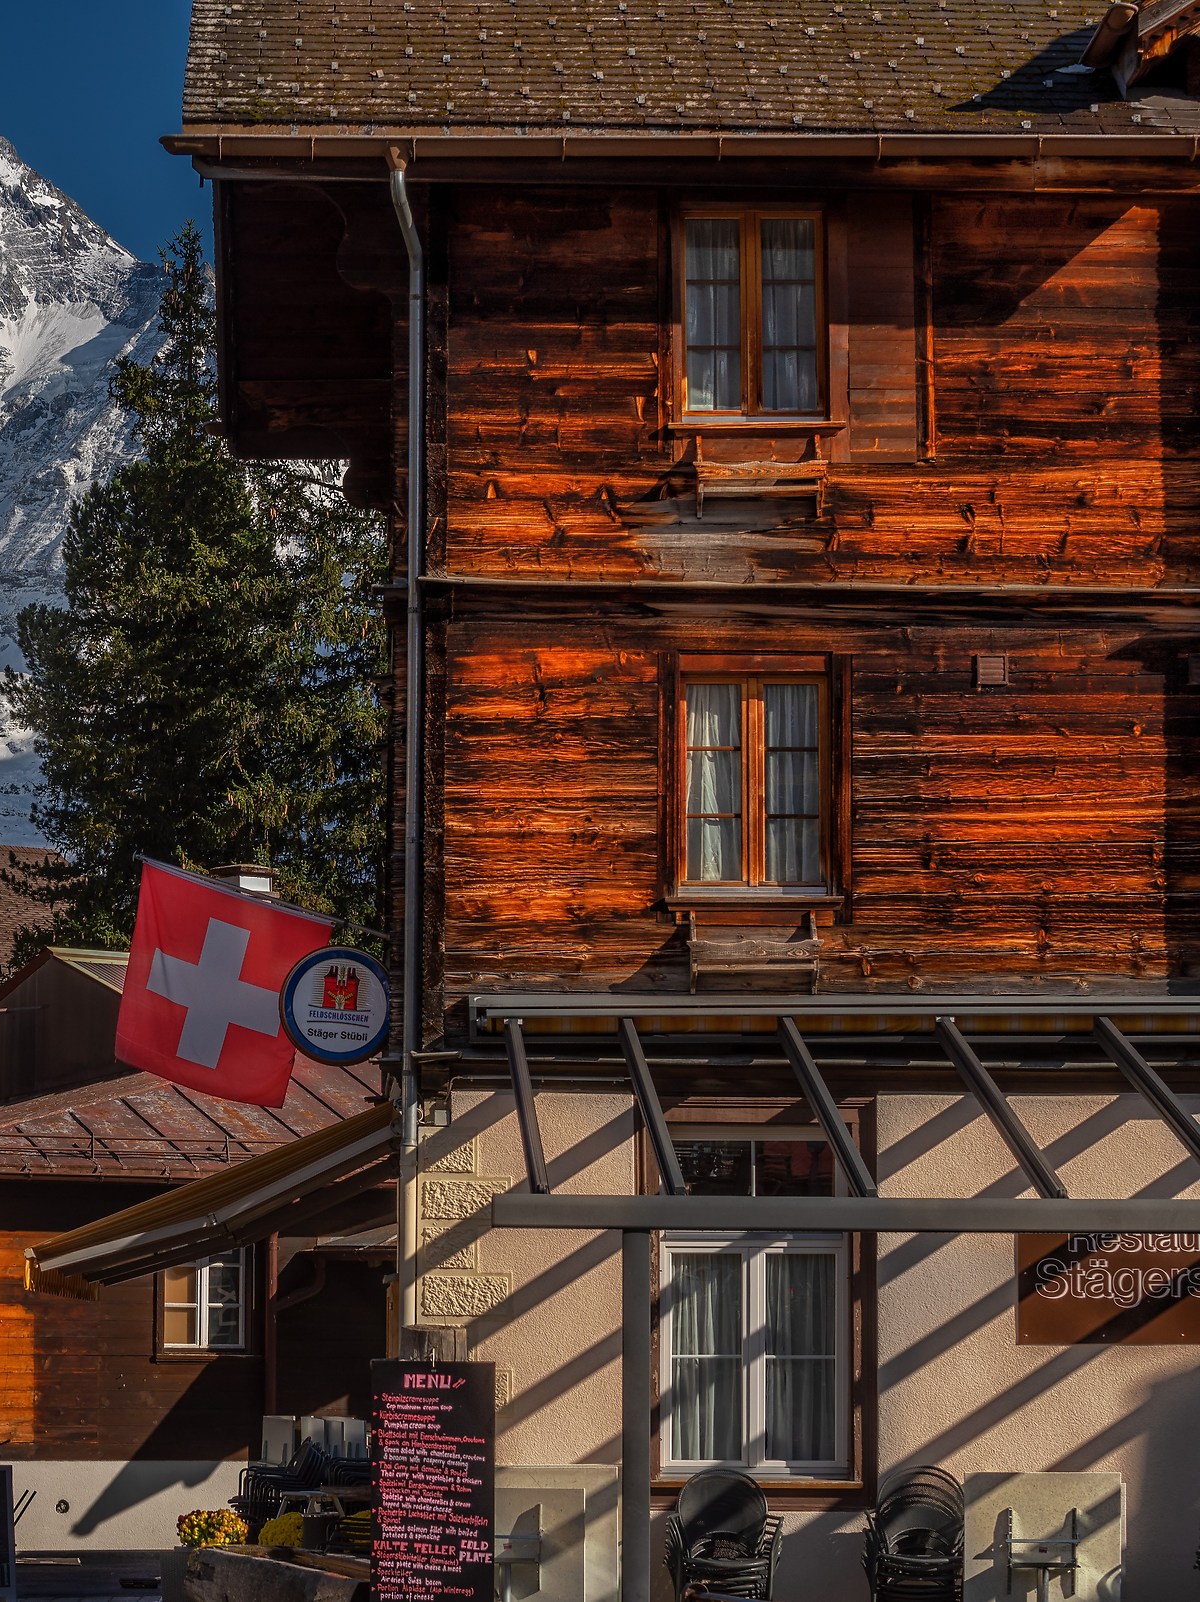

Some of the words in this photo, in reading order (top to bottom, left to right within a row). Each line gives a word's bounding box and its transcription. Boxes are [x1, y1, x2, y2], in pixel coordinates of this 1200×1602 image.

[309, 1010, 368, 1022] FELDSCHLÖSSCHEN
[307, 1028, 338, 1039] Stäger
[341, 1031, 368, 1041] Stübli
[403, 1374, 451, 1389] MENU
[382, 1393, 439, 1404] Steinpilzcremesuppe
[379, 1410, 436, 1423] Kürbiscremesuppe
[384, 1420, 408, 1429] Pumpkin
[427, 1423, 441, 1431] soup
[378, 1429, 407, 1439] Blattsalat
[409, 1431, 419, 1439] mit
[384, 1446, 399, 1454] Green
[416, 1448, 428, 1456] with
[379, 1461, 392, 1469] Thai
[394, 1463, 407, 1471] Curry
[381, 1470, 395, 1478] Thai
[396, 1471, 409, 1479] curry
[412, 1472, 424, 1480] with
[425, 1474, 454, 1483] vegetables
[462, 1477, 482, 1485] chicken
[405, 1494, 416, 1502] with
[382, 1501, 403, 1509] topped
[383, 1516, 401, 1524] Spinat
[437, 1512, 447, 1520] mit
[382, 1524, 405, 1532] Poached
[407, 1525, 428, 1533] salmon
[445, 1526, 456, 1536] with
[458, 1528, 478, 1537] boiled
[382, 1532, 407, 1540] potatoes
[373, 1540, 408, 1551] KALTE
[413, 1543, 456, 1556] TELLER
[459, 1551, 493, 1563] PLATE
[396, 1560, 411, 1569] plate
[413, 1562, 424, 1570] with
[447, 1565, 461, 1573] meat
[390, 1576, 404, 1584] dried
[407, 1576, 422, 1585] Swiss
[425, 1577, 442, 1585] bacon
[376, 1584, 398, 1593] Portion
[380, 1592, 403, 1601] portion
[406, 1592, 413, 1602] of
